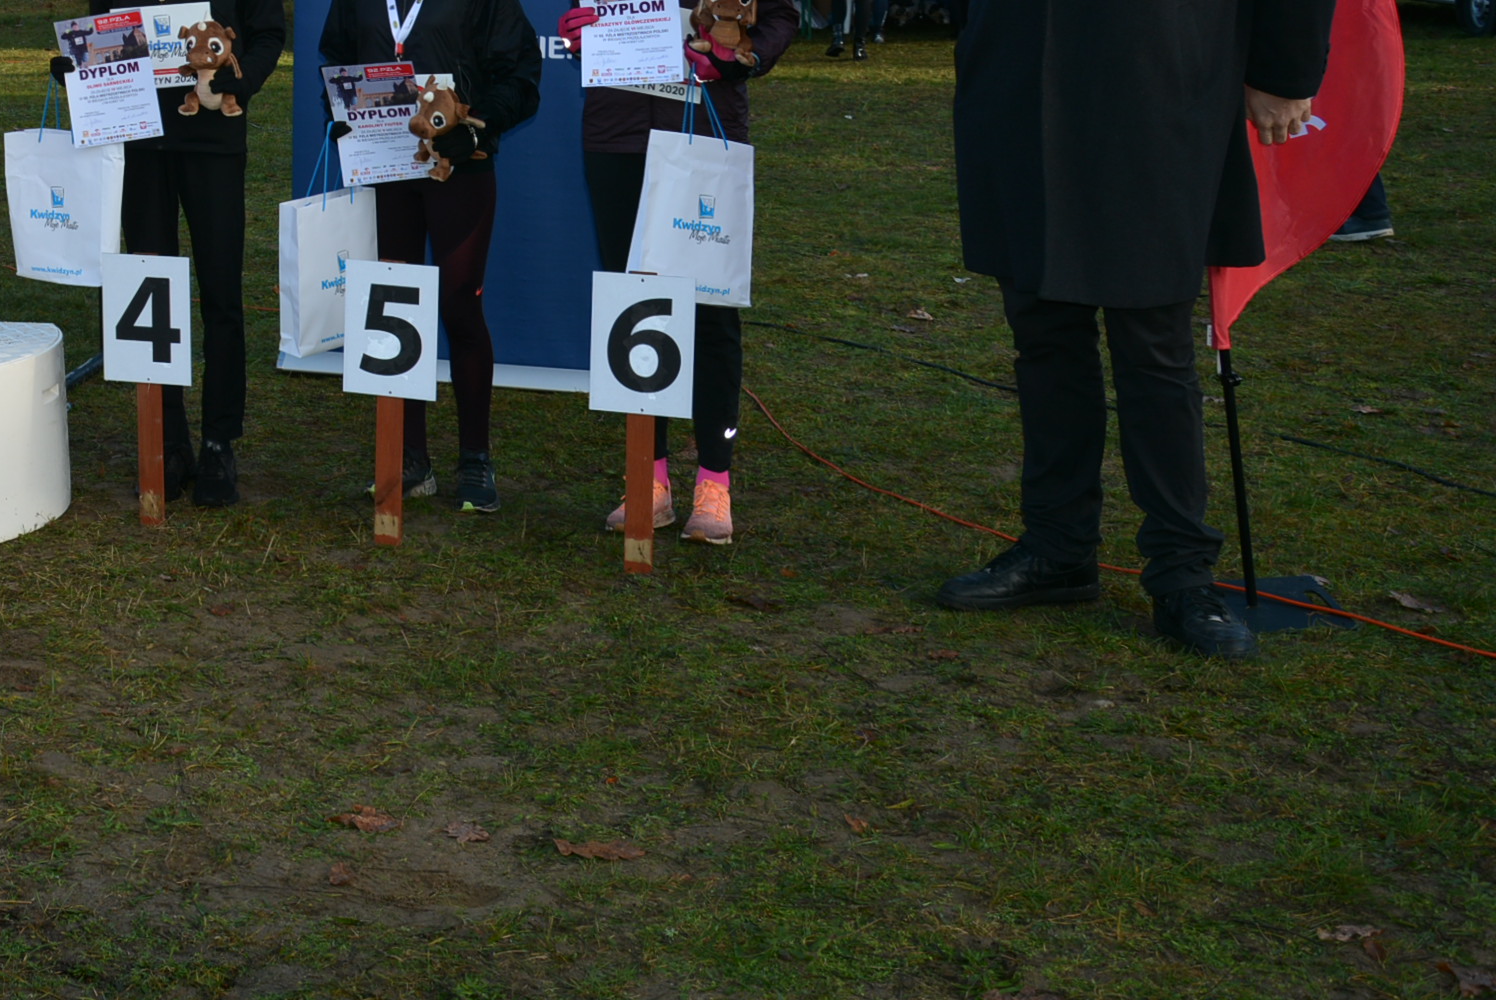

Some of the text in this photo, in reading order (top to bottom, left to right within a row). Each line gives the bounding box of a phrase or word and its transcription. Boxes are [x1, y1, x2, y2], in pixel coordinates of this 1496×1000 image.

[597, 0, 665, 17] DYPLOM
[150, 40, 182, 52] idzyn
[79, 61, 140, 81] DYPLOM
[659, 83, 685, 96] 2020
[347, 107, 411, 121] DYPLOM
[30, 208, 70, 223] Kwidzyn
[672, 217, 721, 235] Kwidzyn
[31, 264, 82, 277] www.kwidzyn.pl
[116, 276, 181, 363] 4
[359, 283, 423, 377] 5
[607, 298, 682, 393] 6
